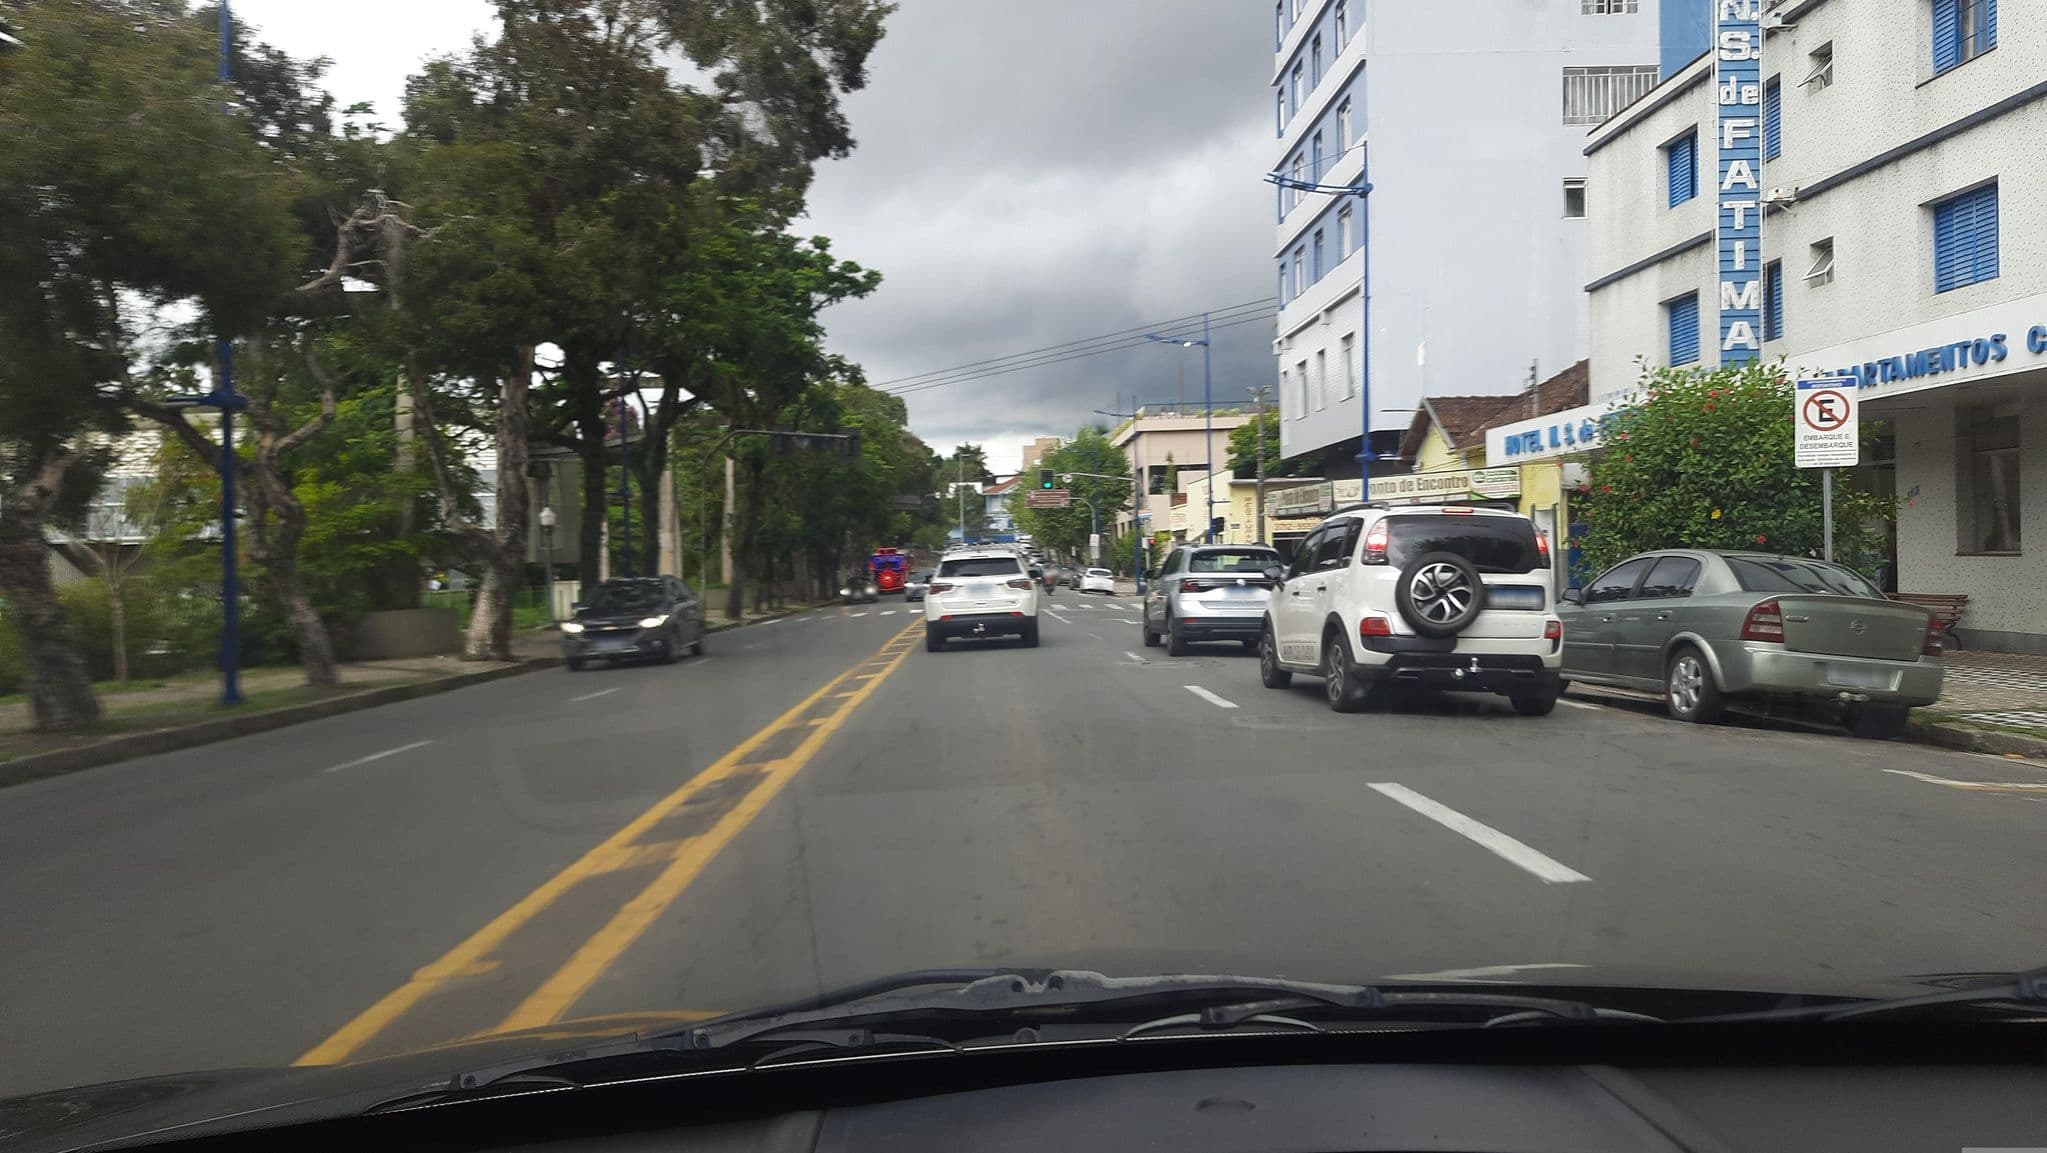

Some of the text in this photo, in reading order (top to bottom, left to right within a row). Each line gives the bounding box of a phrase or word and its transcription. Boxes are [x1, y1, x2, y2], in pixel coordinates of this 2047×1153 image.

[1720, 76, 1759, 105] de
[1720, 119, 1760, 350] FATIMA
[2027, 325, 2047, 354] C
[1799, 442, 1853, 450] DESEMBARQUE
[1803, 433, 1843, 442] EMBARQUE
[1369, 481, 1397, 494] onto
[1399, 479, 1414, 493] de
[1416, 476, 1468, 491] Encontro
